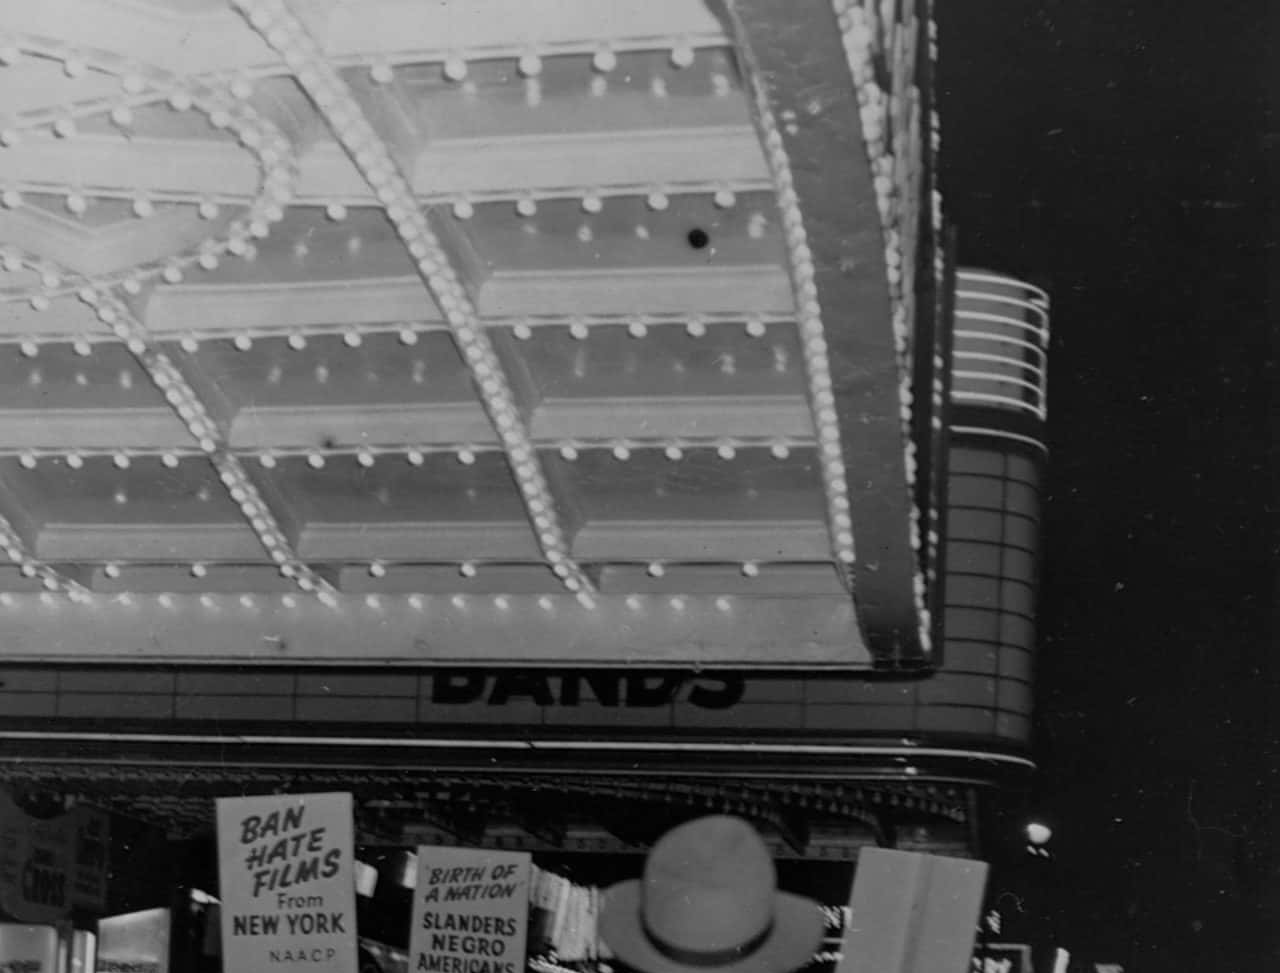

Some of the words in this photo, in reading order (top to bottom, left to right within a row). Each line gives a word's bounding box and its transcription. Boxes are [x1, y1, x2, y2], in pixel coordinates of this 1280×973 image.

[239, 805, 305, 845] BAN
[245, 827, 326, 870] HATE
[253, 848, 342, 898] FILMS
[491, 864, 519, 881] OF
[277, 893, 324, 910] From
[424, 887, 439, 903] A
[233, 914, 281, 936] NEW
[287, 912, 346, 936] YORK
[423, 911, 518, 937] SLANDERS
[431, 934, 506, 957] NEGRO
